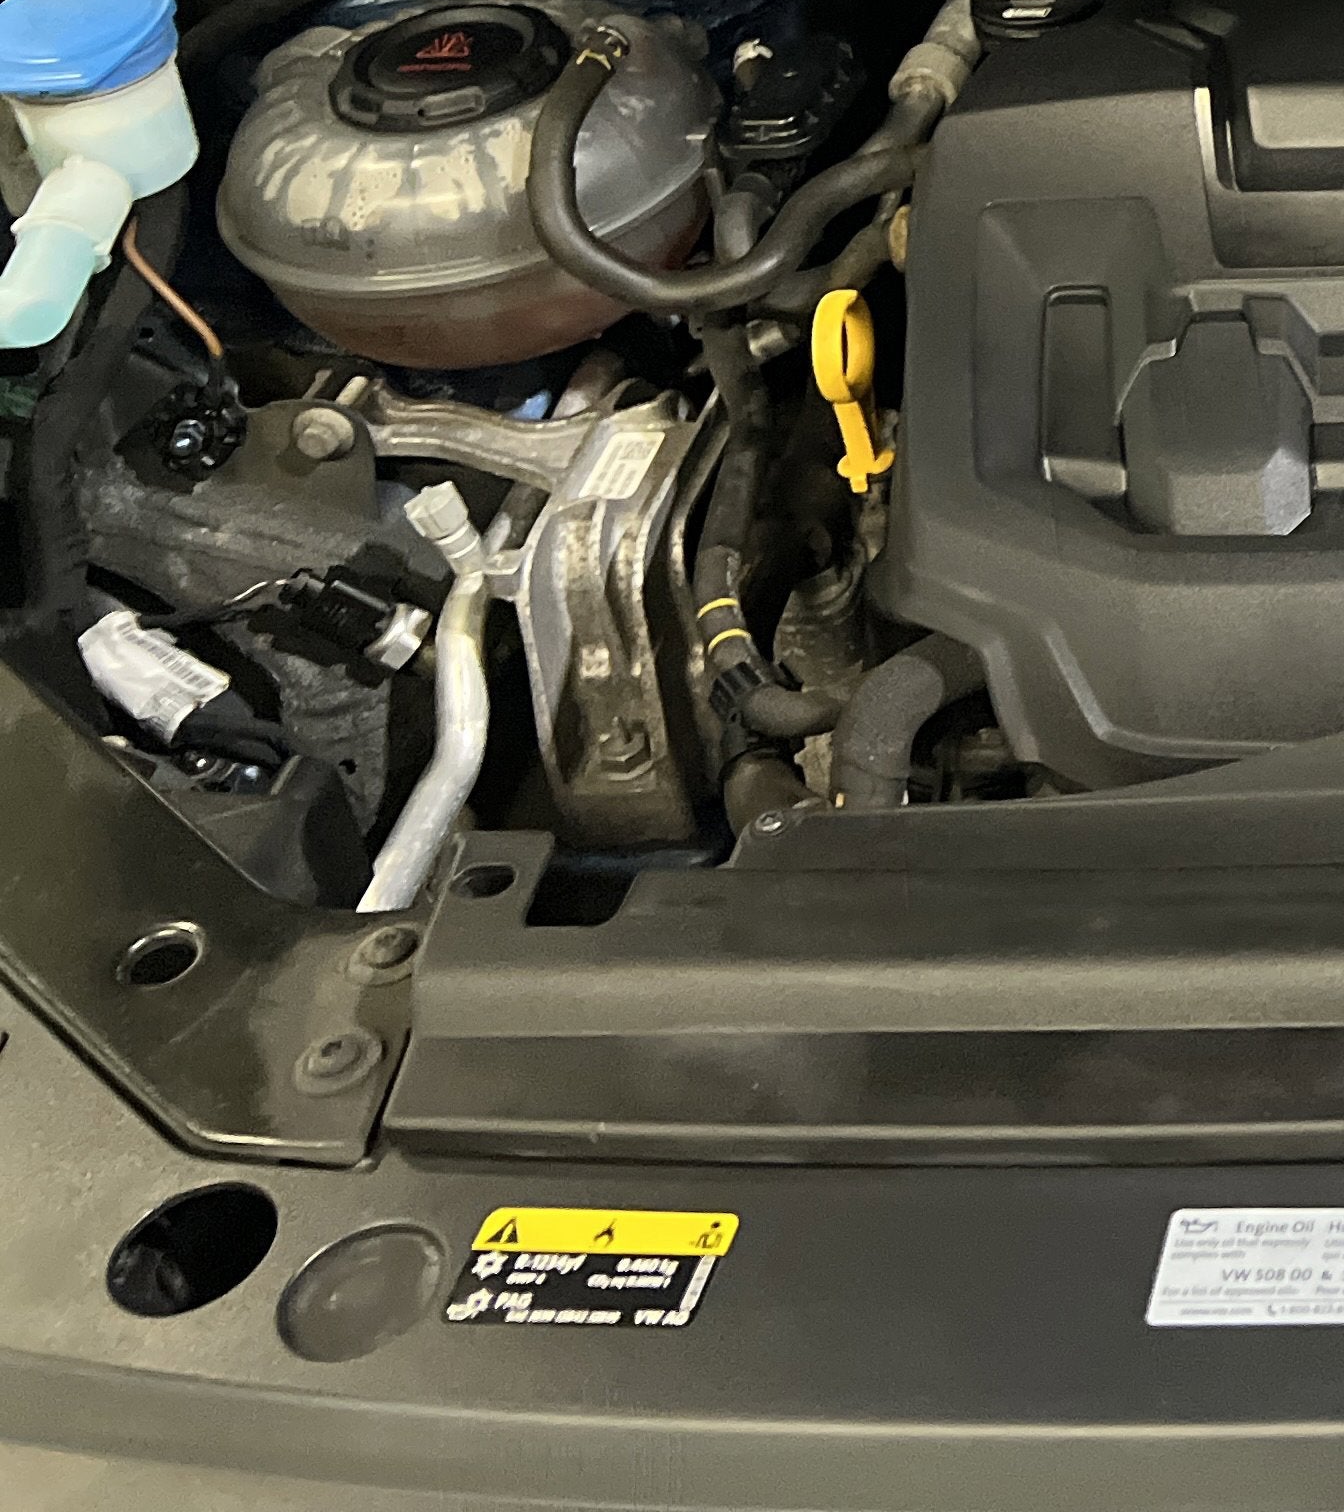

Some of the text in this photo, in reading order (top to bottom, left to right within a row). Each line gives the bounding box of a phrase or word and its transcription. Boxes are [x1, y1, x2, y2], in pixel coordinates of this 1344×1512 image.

[1235, 1219, 1315, 1237] Engine Oil
[1222, 1268, 1252, 1281] VW
[1254, 1268, 1286, 1281] 508
[1289, 1268, 1312, 1281] 00
[1321, 1270, 1333, 1281] &
[634, 1309, 666, 1326] VW
